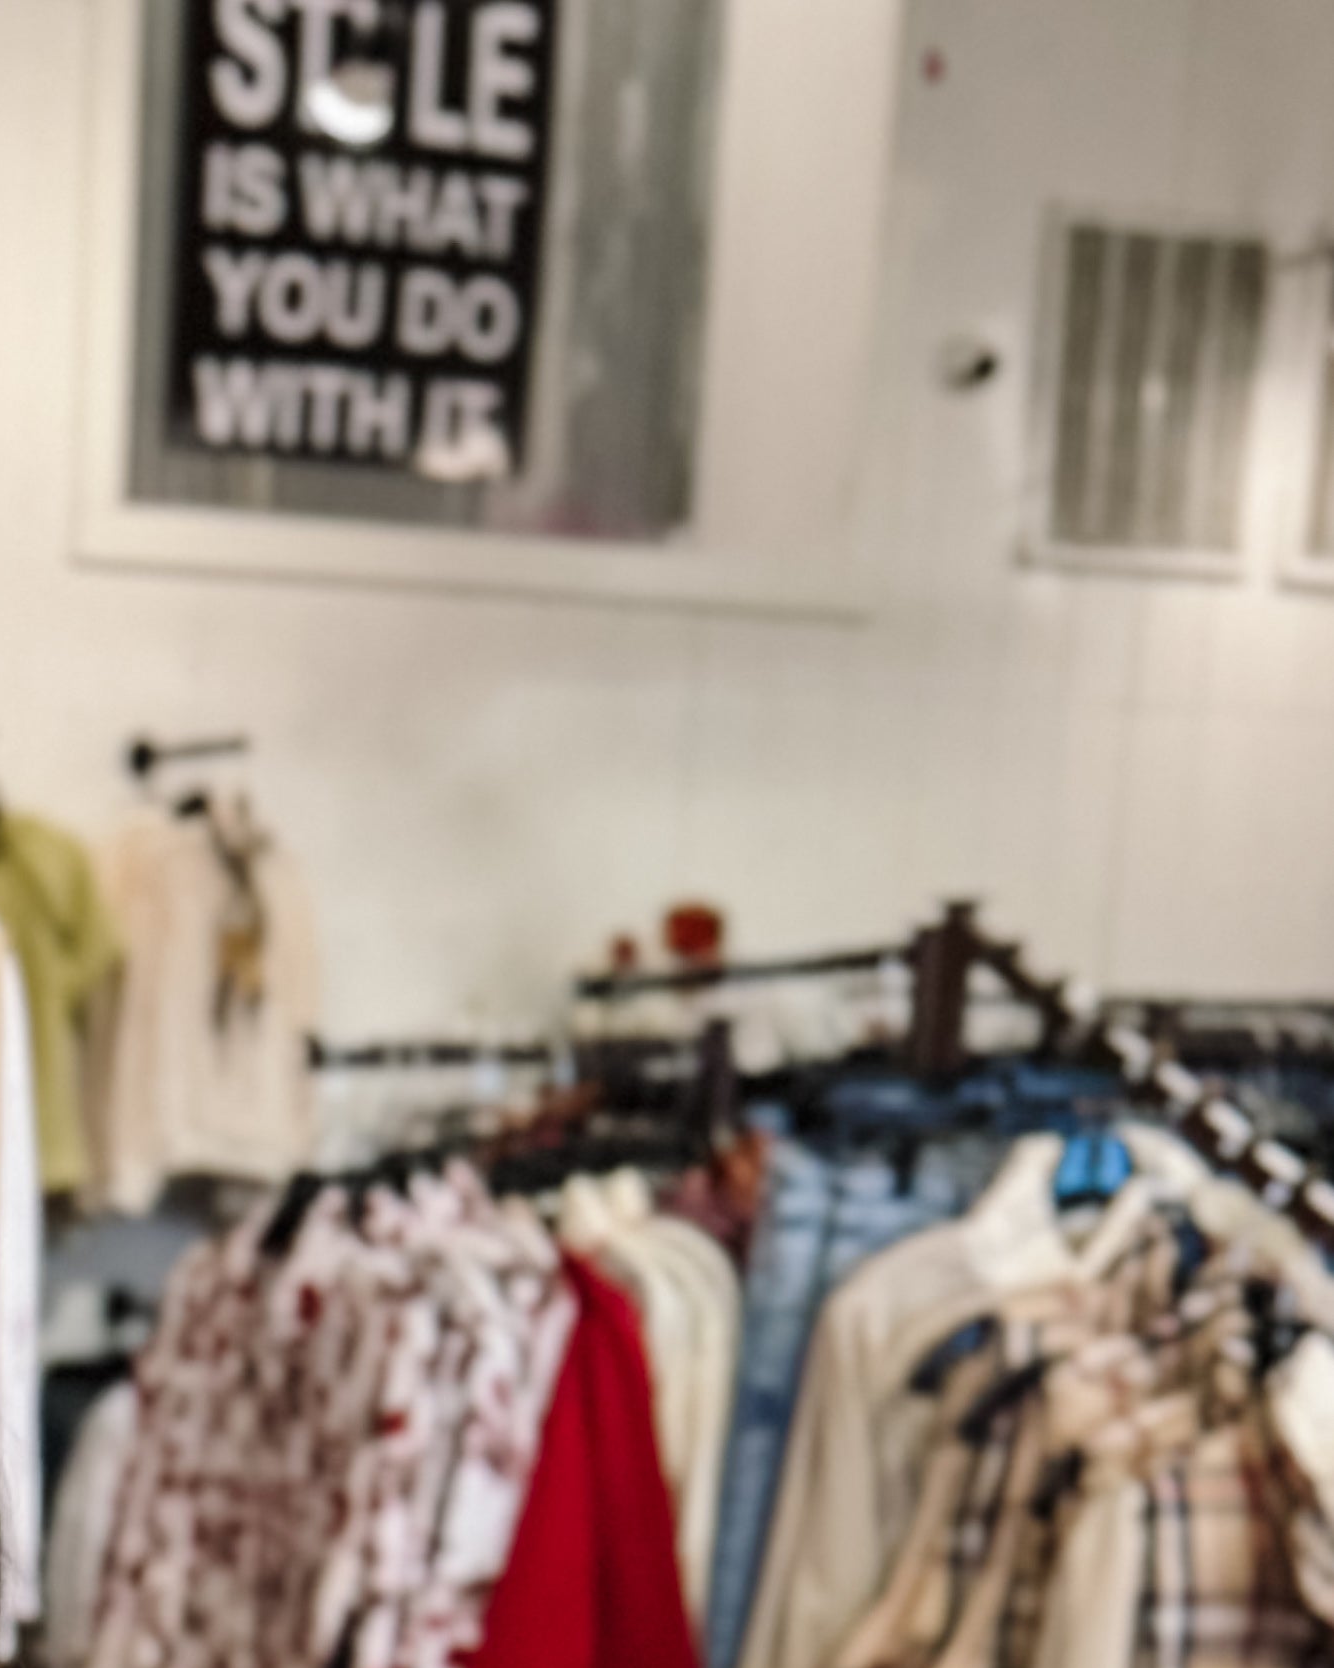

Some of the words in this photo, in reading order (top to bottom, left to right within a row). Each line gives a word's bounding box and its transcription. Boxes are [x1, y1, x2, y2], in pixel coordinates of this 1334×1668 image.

[208, 0, 539, 160] STLE
[201, 144, 287, 236] IS
[298, 153, 528, 261] WHAT
[203, 248, 384, 347] YOU
[395, 269, 521, 363] DO
[193, 357, 411, 456] WITH
